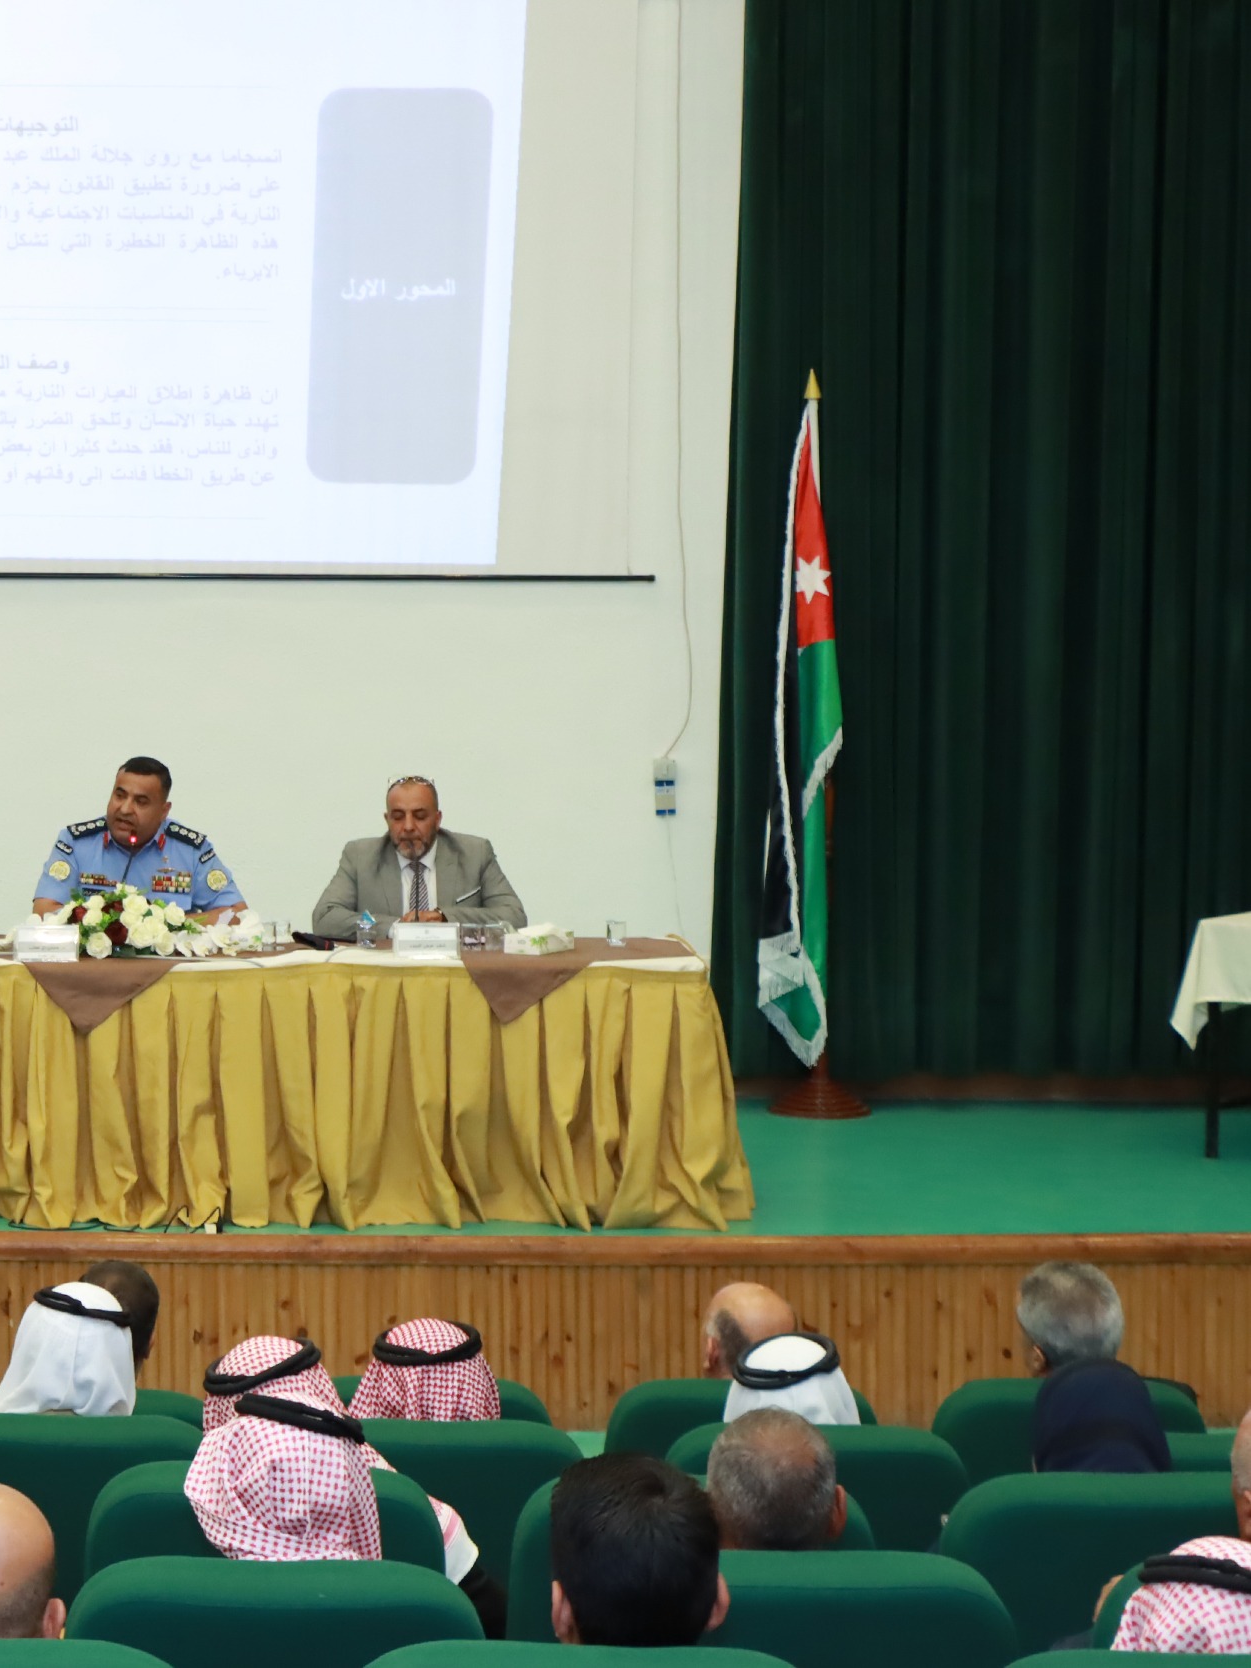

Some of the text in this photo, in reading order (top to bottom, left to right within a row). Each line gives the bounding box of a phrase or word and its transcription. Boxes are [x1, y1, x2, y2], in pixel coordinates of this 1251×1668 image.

[2, 148, 29, 166] عبد
[40, 145, 81, 162] الملك
[91, 144, 133, 167] جلالة
[190, 152, 212, 170] مع
[12, 175, 50, 194] بحزم
[59, 175, 114, 194] القانون
[124, 174, 172, 196] تطبيق
[181, 175, 241, 195] ضرورة
[249, 177, 280, 198] على
[27, 201, 109, 223] الاجتماعية
[117, 203, 194, 223] المناسبات
[201, 202, 224, 228] في
[232, 203, 280, 226] النارية
[6, 232, 49, 251] تشكل
[61, 232, 91, 254] التي
[105, 232, 165, 252] الخطيرة
[179, 232, 238, 253] الظاهرة
[253, 231, 278, 249] هذه
[394, 278, 456, 301] المحور
[16, 353, 70, 374] وصف
[15, 380, 65, 402] النارية
[75, 384, 137, 404] العيارات
[203, 385, 252, 405] ظاهرة
[25, 410, 73, 430] الضرر
[81, 411, 132, 431] وتلحق
[204, 412, 237, 430] حياة
[245, 414, 279, 432] تهدد
[106, 438, 143, 455] حدث
[149, 437, 173, 456] فقد
[201, 466, 245, 487] طريق
[250, 468, 275, 487] عن
